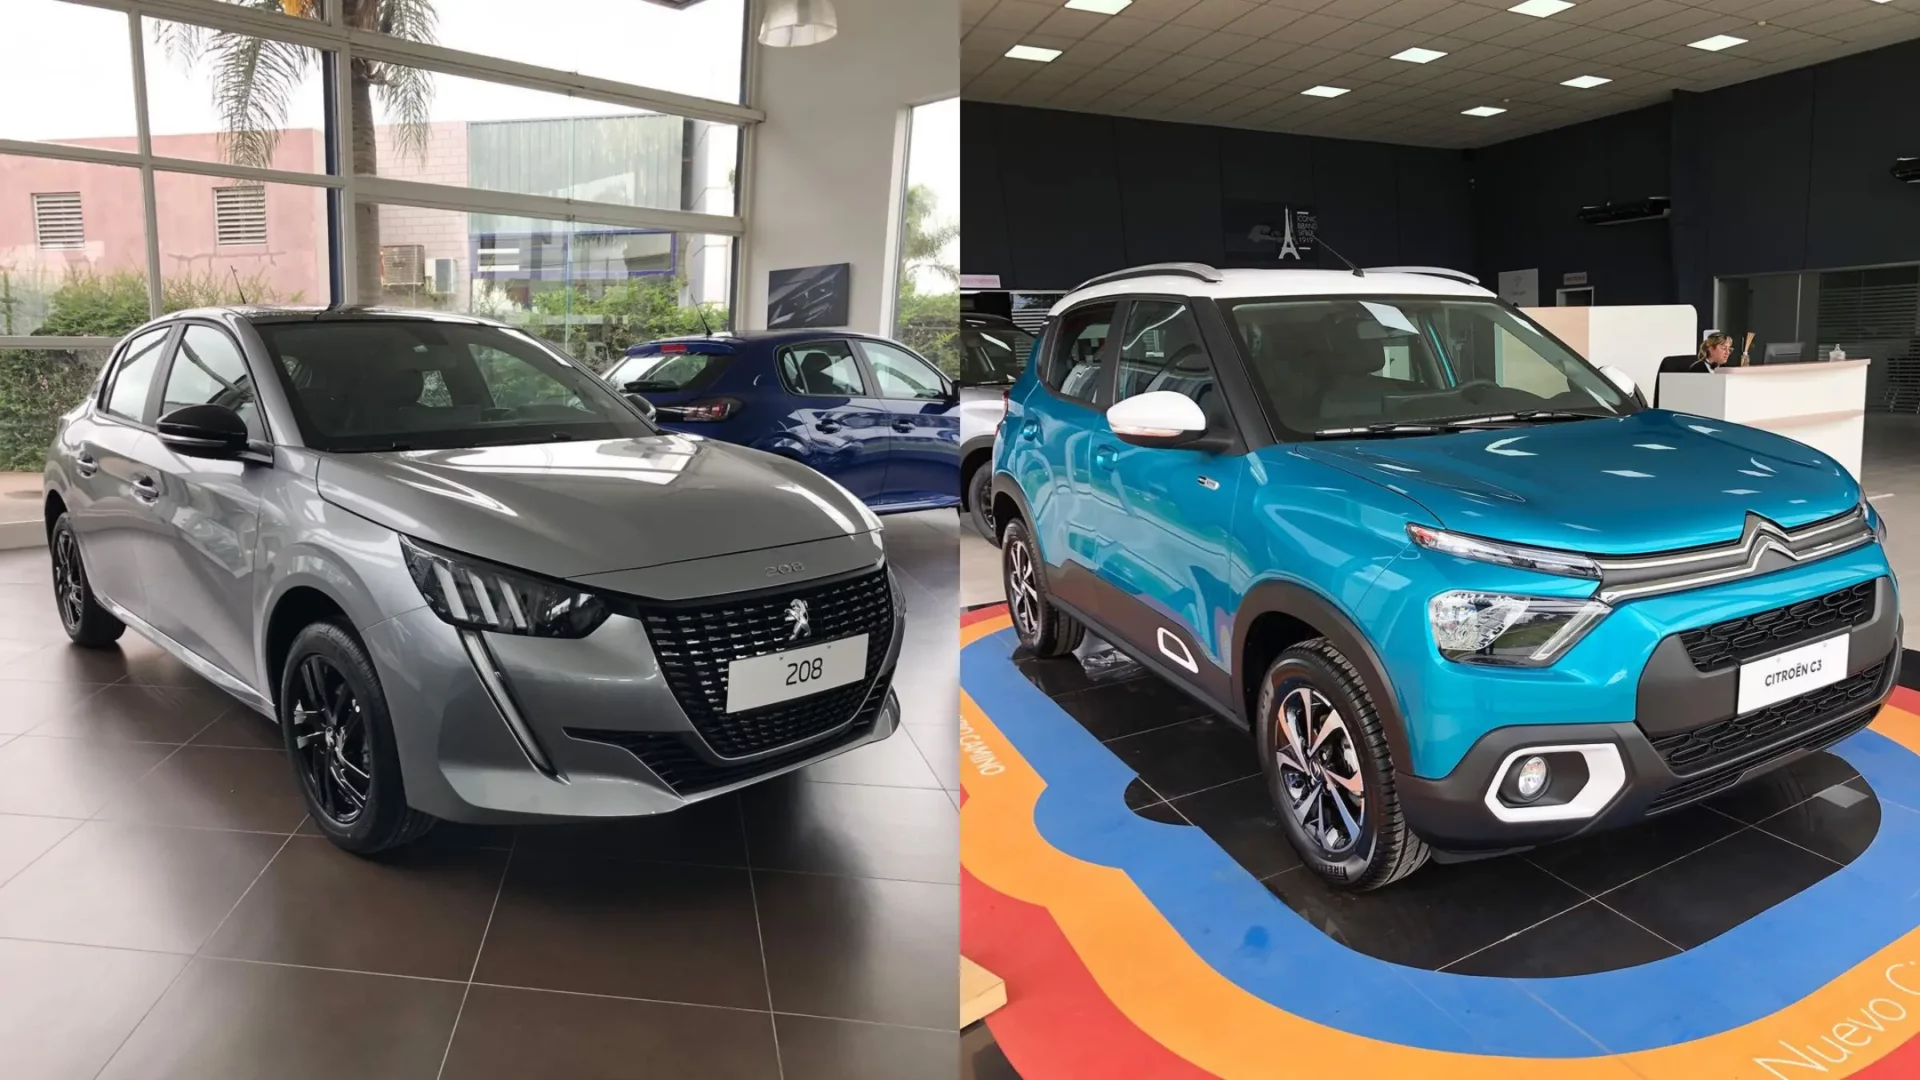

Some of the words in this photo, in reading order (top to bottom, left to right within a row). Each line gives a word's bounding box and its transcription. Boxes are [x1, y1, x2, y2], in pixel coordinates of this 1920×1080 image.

[764, 560, 805, 578] 208
[785, 657, 823, 687] 208
[1765, 663, 1809, 687] CITROËN
[1810, 659, 1822, 672] C3
[1752, 998, 1906, 1080] Nuevo
